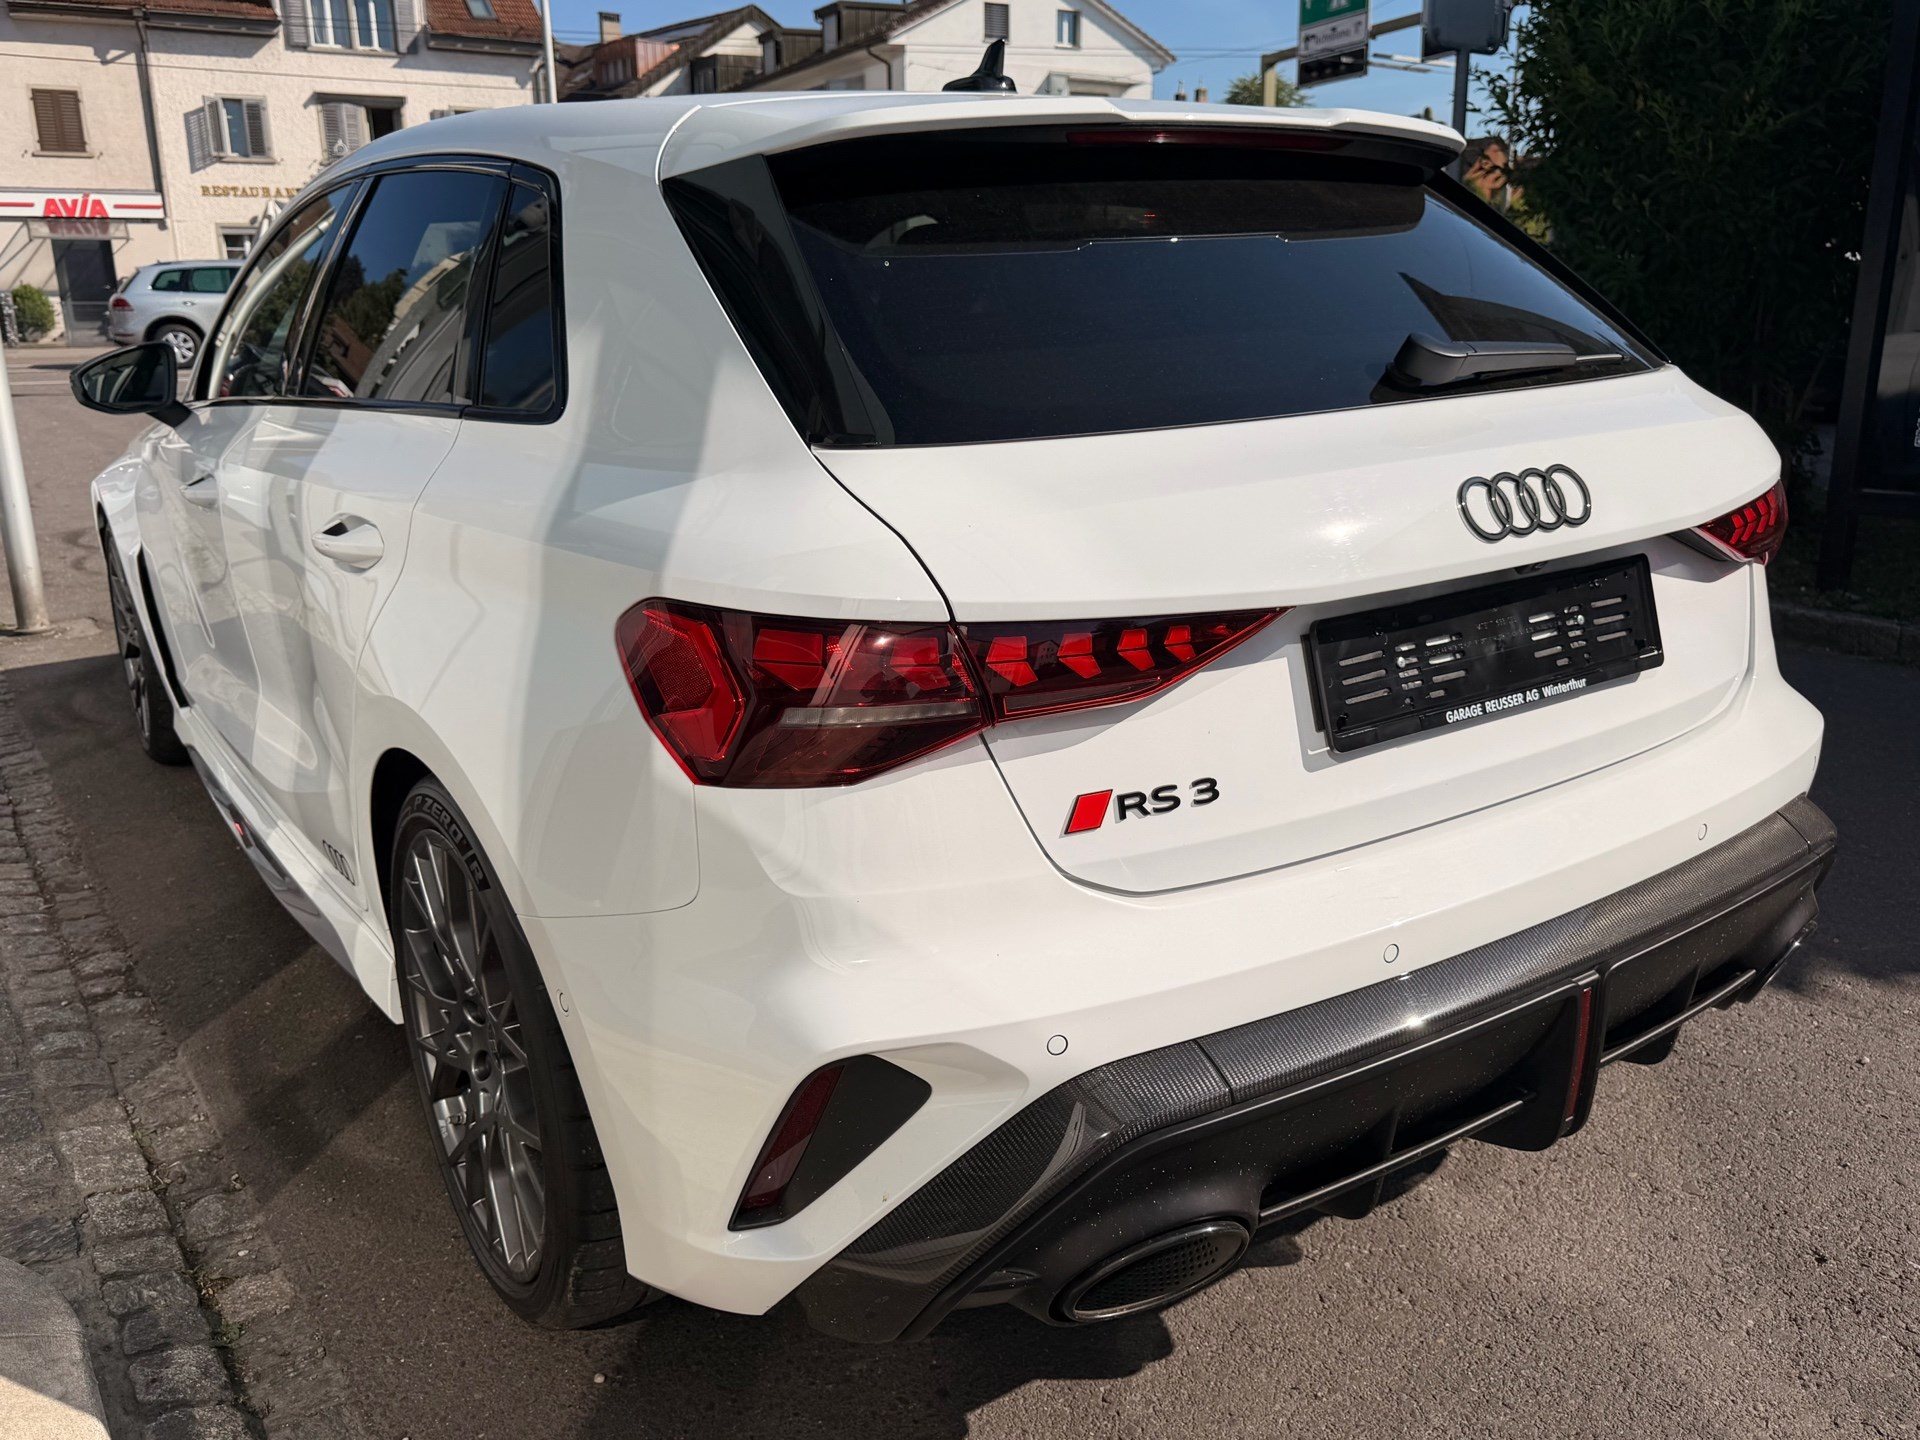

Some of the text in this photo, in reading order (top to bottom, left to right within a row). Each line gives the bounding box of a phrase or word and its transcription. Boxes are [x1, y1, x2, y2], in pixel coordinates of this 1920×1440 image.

[201, 185, 301, 199] RESTAURAN
[1446, 678, 1587, 724] GARAGE REUSSER AG Winterthur
[414, 796, 422, 809] P
[422, 797, 463, 842] ZERO
[1114, 777, 1220, 823] RS 3
